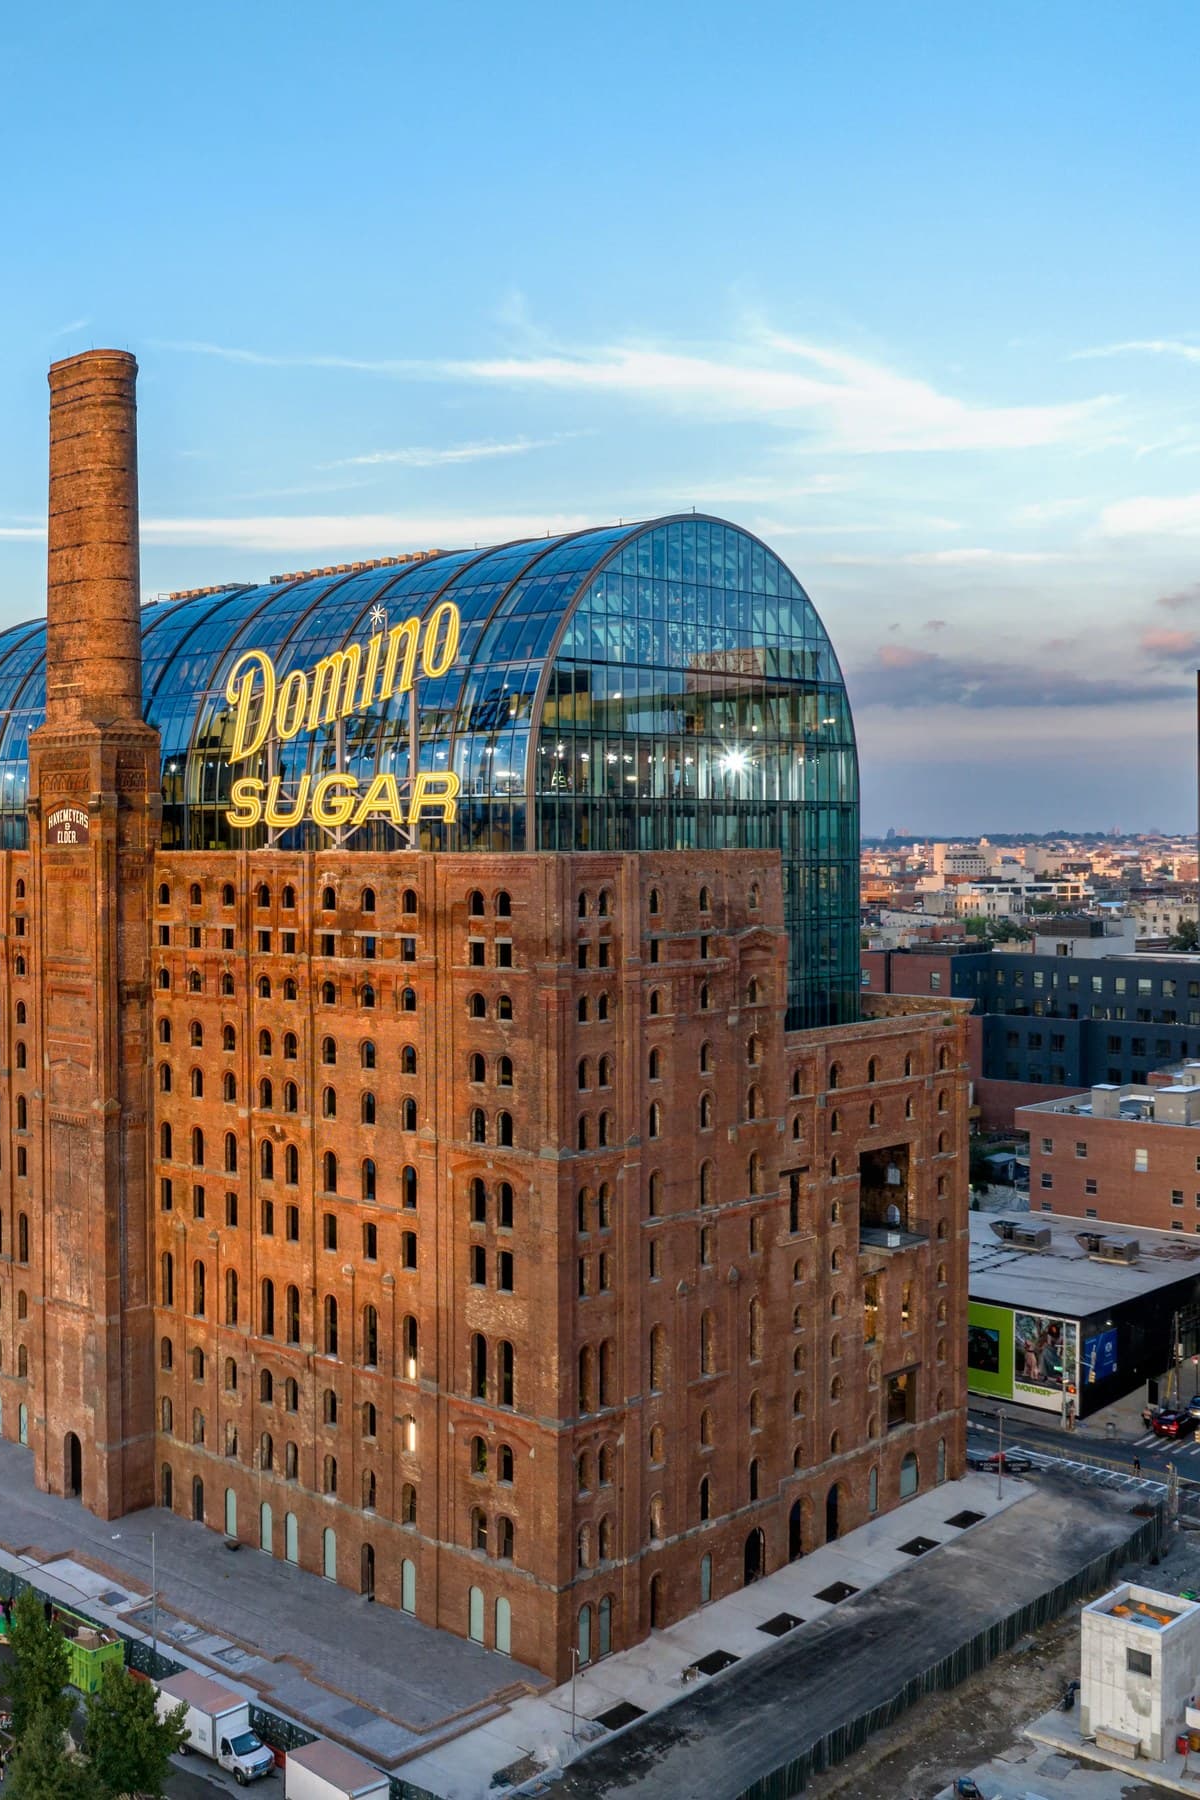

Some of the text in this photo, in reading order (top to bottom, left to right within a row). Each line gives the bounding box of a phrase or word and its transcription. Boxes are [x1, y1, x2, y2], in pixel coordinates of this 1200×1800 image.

[225, 601, 460, 765] Domino
[48, 808, 88, 830] HAVEMEYERS
[226, 771, 460, 828] SUGAR
[64, 822, 71, 831] &
